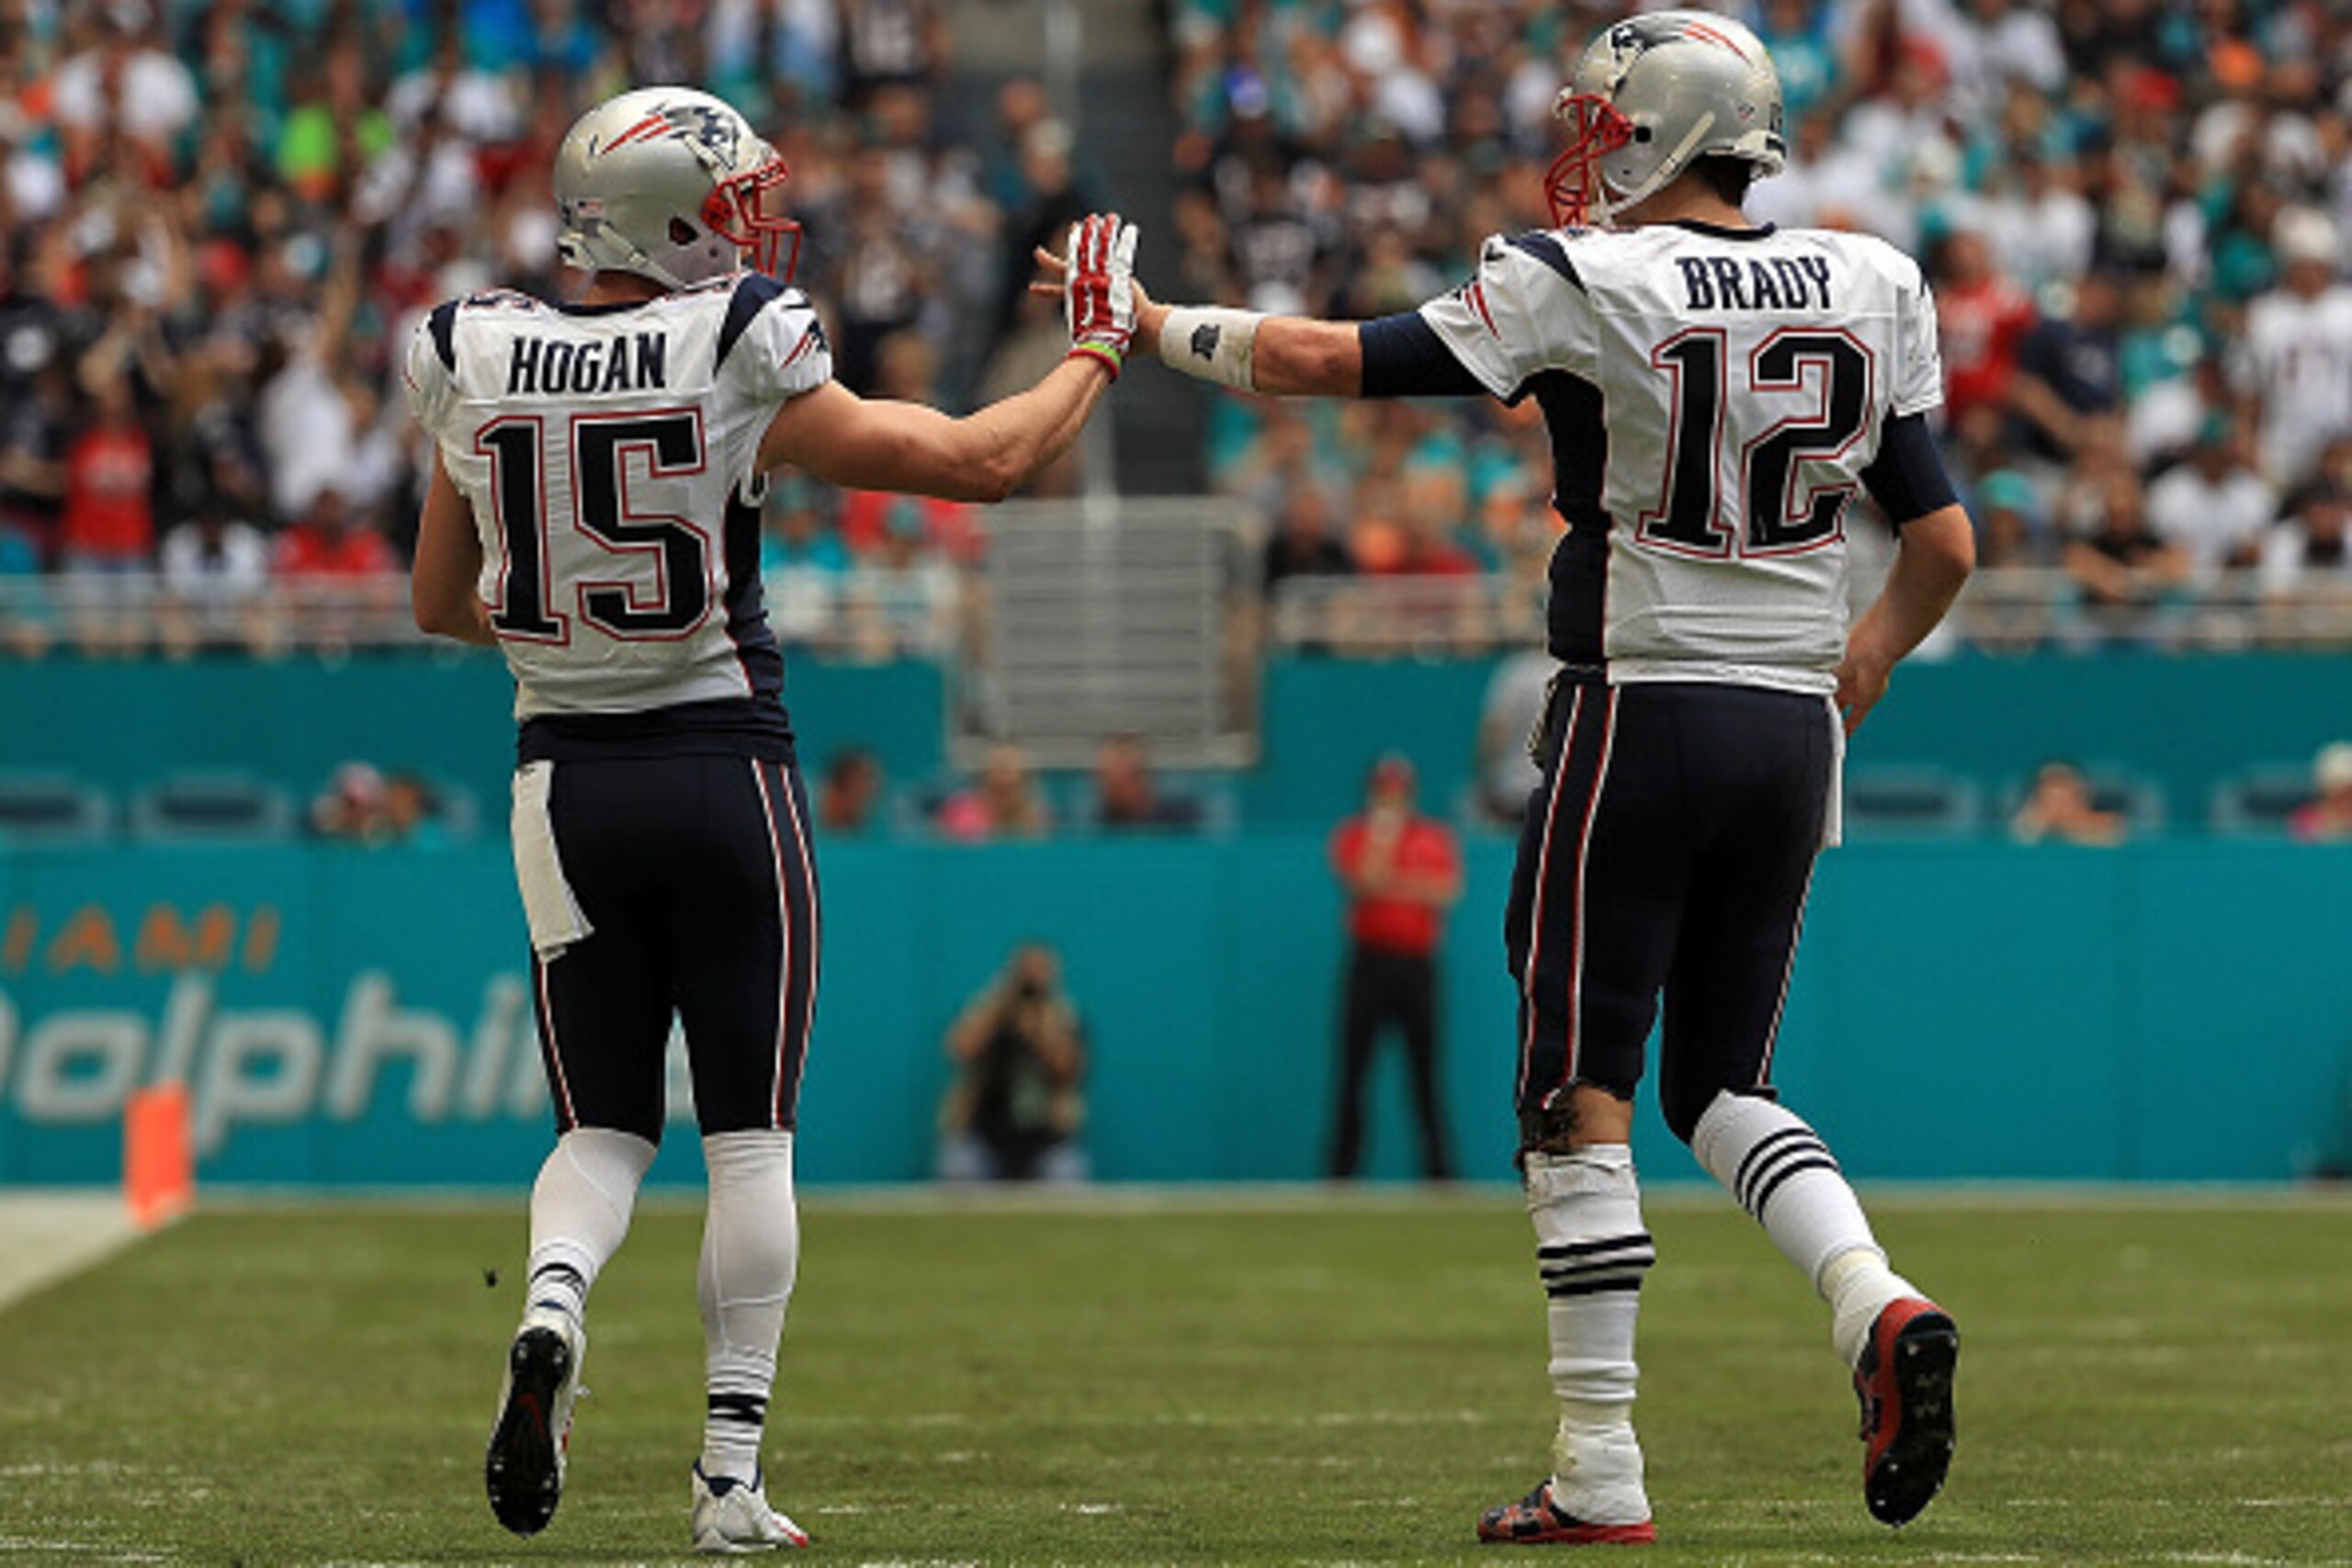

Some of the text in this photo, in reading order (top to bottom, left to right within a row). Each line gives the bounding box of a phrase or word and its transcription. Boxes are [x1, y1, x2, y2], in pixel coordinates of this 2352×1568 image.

[1675, 256, 1832, 310] BRADY
[507, 332, 666, 395] HOGAN
[1635, 325, 1873, 558] 12
[474, 404, 714, 645] 15
